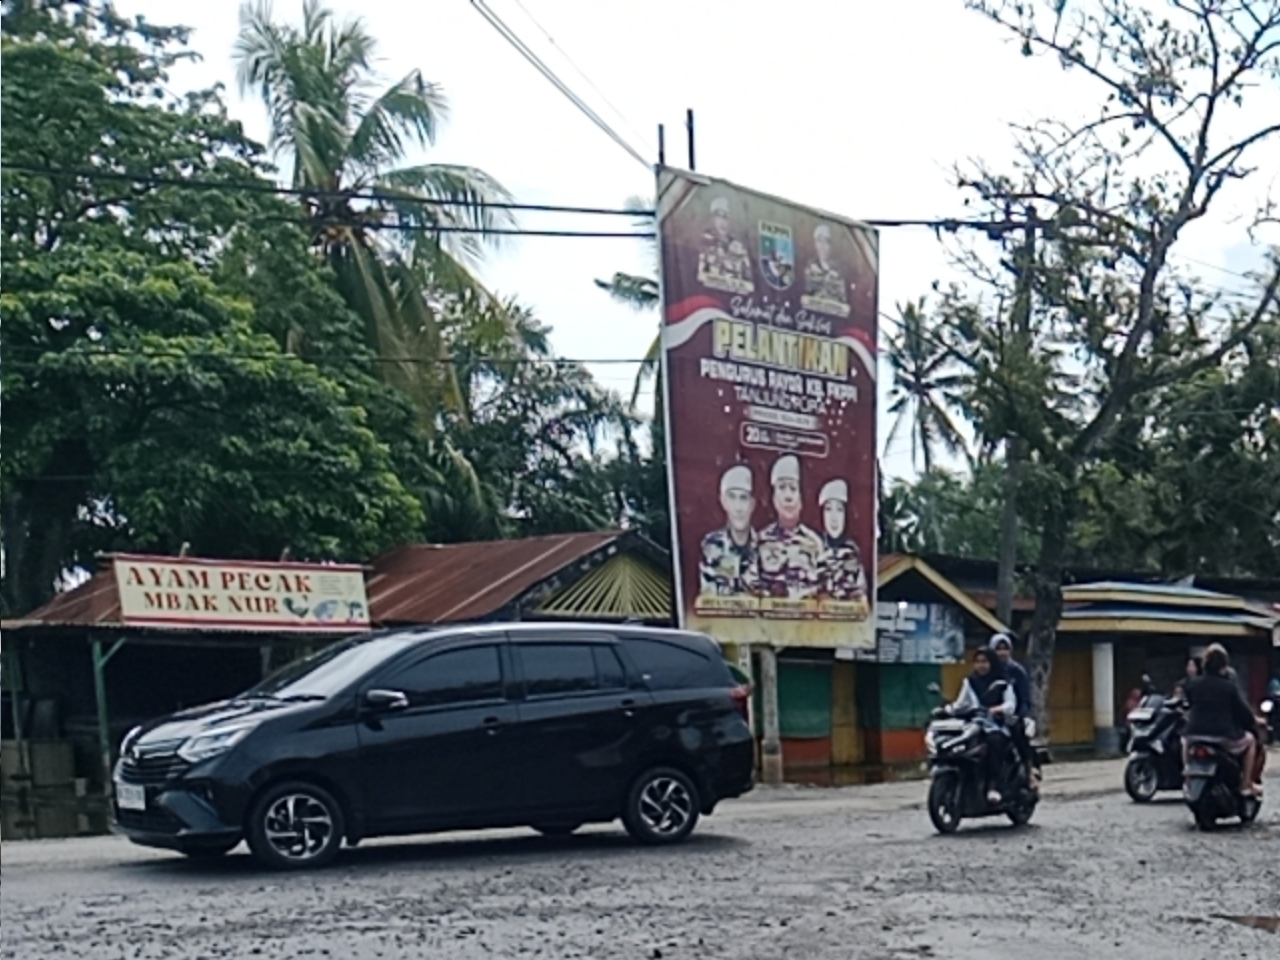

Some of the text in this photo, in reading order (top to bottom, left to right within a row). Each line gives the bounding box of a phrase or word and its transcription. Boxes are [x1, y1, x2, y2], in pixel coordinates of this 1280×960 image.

[713, 318, 849, 380] PELANTIKAN
[700, 358, 767, 386] PENGURUS
[734, 386, 828, 415] TANJUNG PURA
[127, 566, 210, 588] AYAM
[220, 571, 313, 594] PECAK
[145, 591, 280, 614] MBAK NUR
